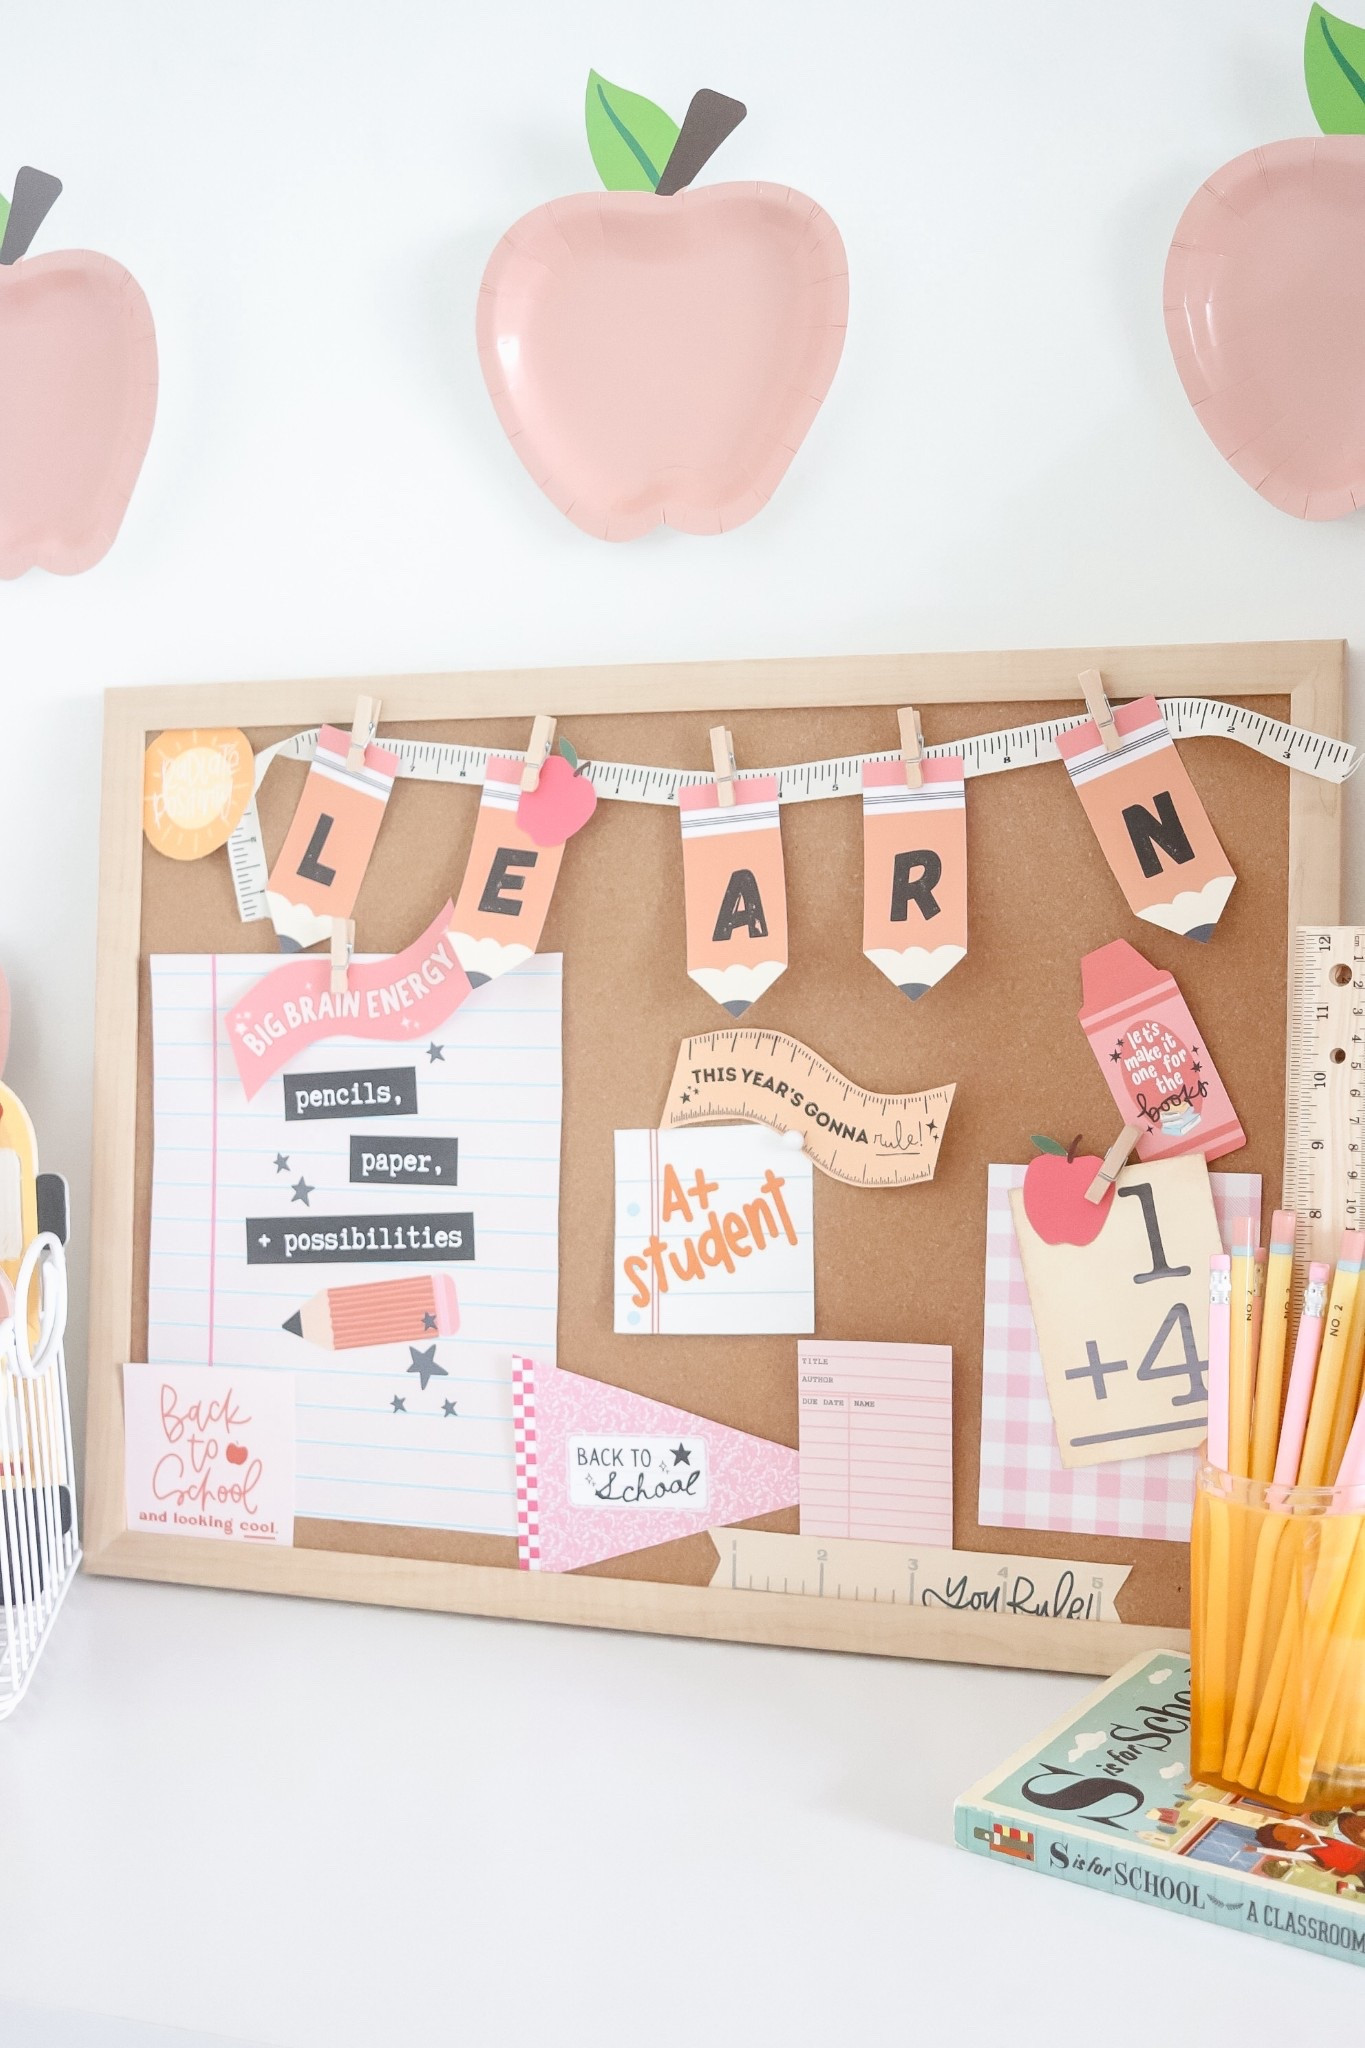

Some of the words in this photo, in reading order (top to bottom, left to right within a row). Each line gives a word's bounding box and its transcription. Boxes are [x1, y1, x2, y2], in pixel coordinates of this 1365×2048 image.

[1227, 725, 1235, 733] 2
[1003, 756, 1011, 764] 8
[1282, 751, 1291, 759] 3
[667, 792, 675, 800] 2
[1319, 935, 1331, 951] 12
[1354, 935, 1360, 947] cm
[242, 1012, 287, 1057] BIG
[283, 989, 361, 1030] BRAIN
[366, 942, 454, 1019] ENERGY
[1316, 1005, 1329, 1020] 11
[1352, 1007, 1363, 1015] 3
[1126, 1022, 1160, 1050] let's
[1351, 1034, 1362, 1042] 4
[1124, 1045, 1162, 1072] make
[1161, 1032, 1177, 1053] it
[1131, 1064, 1158, 1085] one
[1162, 1048, 1187, 1073] for
[1350, 1061, 1362, 1069] 5
[1156, 1071, 1184, 1094] the
[1313, 1072, 1326, 1088] 10
[295, 1082, 402, 1114] pencils,
[1349, 1088, 1360, 1097] 6
[692, 1067, 737, 1084] THIS
[741, 1068, 804, 1107] YEAR'S
[804, 1102, 868, 1144] GONNA
[873, 1120, 923, 1151] rule!
[1136, 1080, 1209, 1122] books
[1349, 1116, 1360, 1124] 7
[1311, 1140, 1324, 1150] 9
[1347, 1143, 1359, 1152] 8
[361, 1152, 442, 1177] paper,
[1347, 1170, 1358, 1179] 9
[662, 1163, 719, 1222] A+
[1308, 1210, 1322, 1219] 8
[1346, 1199, 1356, 1214] 10
[284, 1225, 463, 1257] possibilities
[623, 1169, 798, 1308] student
[1117, 1182, 1191, 1284] 1
[801, 1357, 829, 1365] TITLE
[801, 1375, 834, 1383] AUTHOR
[802, 1397, 818, 1405] DUE
[823, 1399, 844, 1407] DATE
[853, 1399, 875, 1408] NAME
[160, 1383, 252, 1443] Back
[187, 1433, 219, 1472] to
[577, 1447, 624, 1467] BACK
[630, 1448, 651, 1468] TO
[152, 1453, 262, 1515] School
[594, 1470, 700, 1503] School
[139, 1510, 167, 1522] and
[173, 1512, 233, 1535] looking
[816, 1549, 828, 1561] 2
[907, 1558, 919, 1571] 3
[997, 1566, 1009, 1578] 4
[1091, 1576, 1104, 1589] 5
[922, 1575, 1001, 1613] You
[1109, 1667, 1191, 1753] Scho
[1106, 1743, 1143, 1766] for
[1096, 1762, 1125, 1777] is
[1021, 1762, 1145, 1831] S
[1050, 1841, 1069, 1869] S
[1072, 1854, 1086, 1871] is
[1087, 1856, 1111, 1877] for
[1114, 1861, 1206, 1911] SCHOOL
[1246, 1900, 1259, 1924] A
[1263, 1904, 1365, 1955] CLASSROOM
